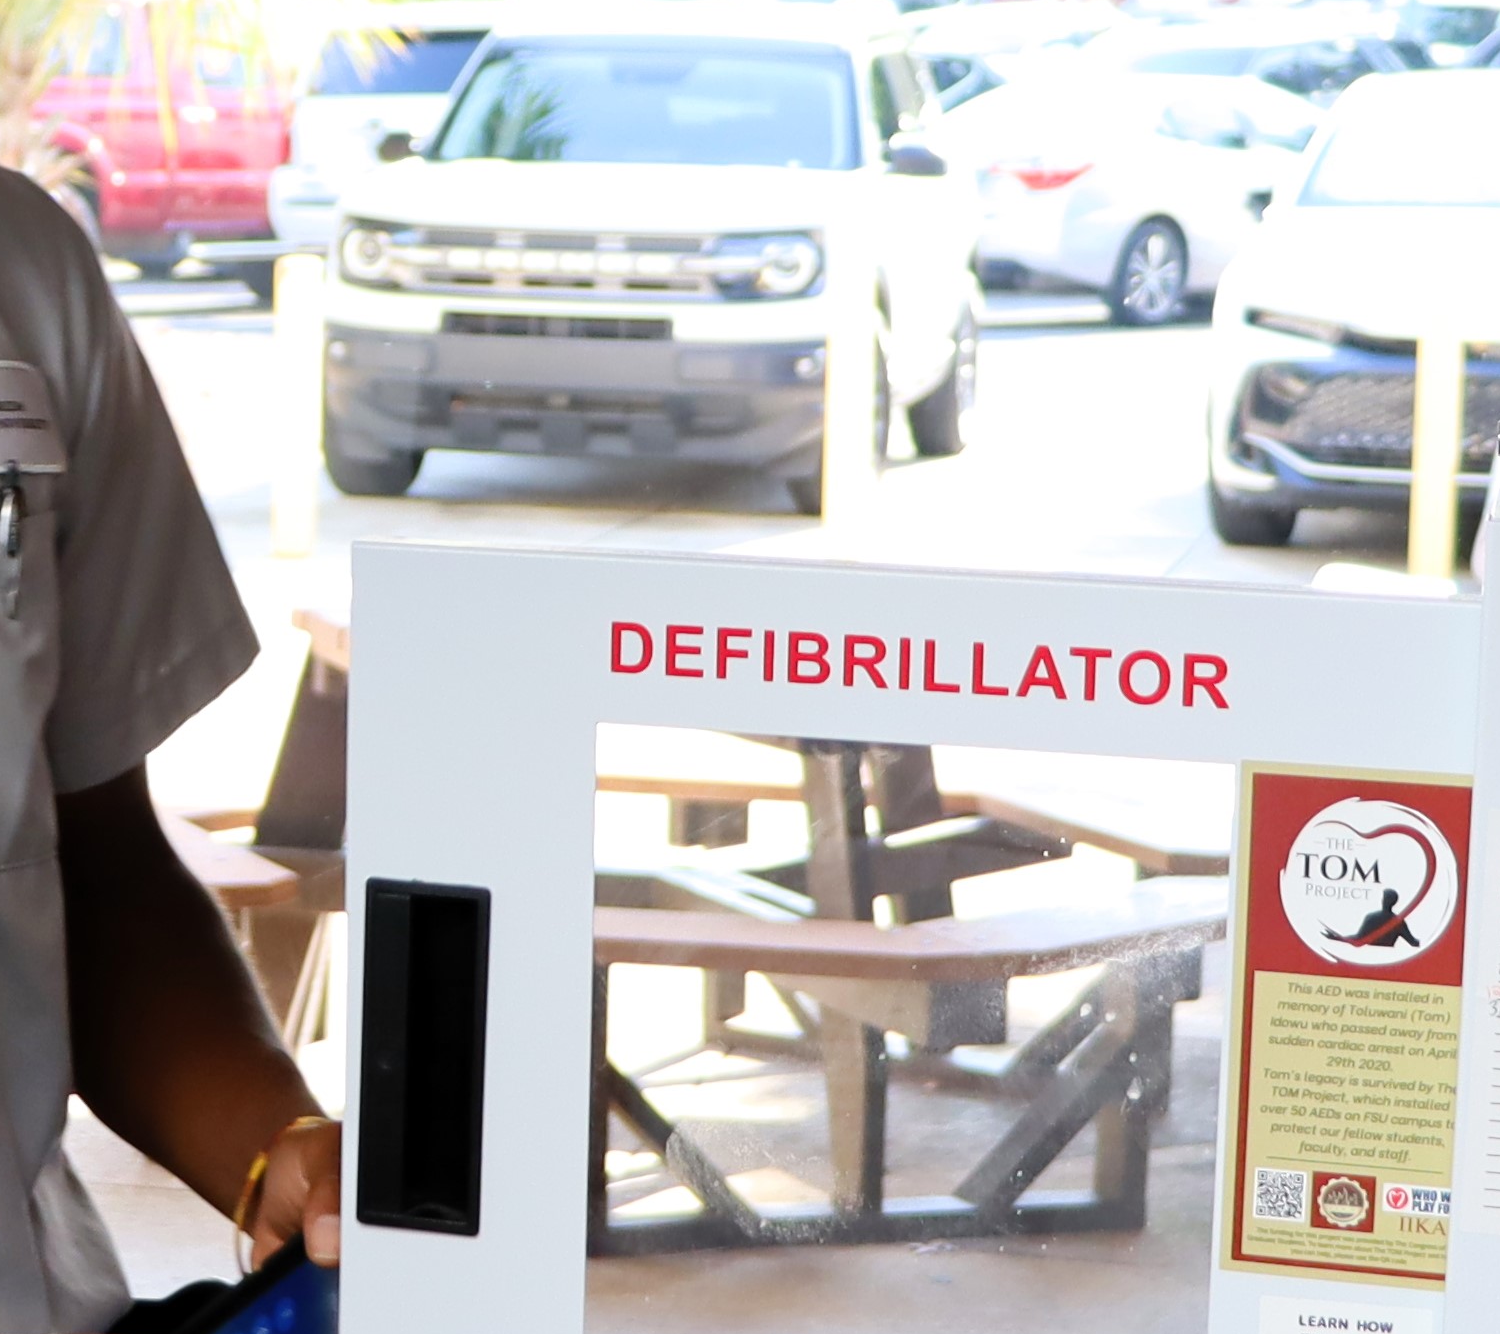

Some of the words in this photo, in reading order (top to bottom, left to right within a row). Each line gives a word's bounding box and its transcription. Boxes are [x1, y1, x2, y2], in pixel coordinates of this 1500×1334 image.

[610, 621, 1231, 709] DEFIBRILLATOR
[1325, 837, 1353, 850] THE
[1296, 853, 1381, 884] TOM
[1305, 884, 1371, 900] PROJECT
[1288, 983, 1313, 994] This
[1315, 985, 1342, 997] AED
[1345, 989, 1370, 999] was
[1374, 987, 1429, 1004] installed
[1432, 993, 1444, 1004] in
[1278, 1001, 1330, 1015] memory
[1333, 1005, 1346, 1017] of
[1349, 1005, 1407, 1018] Toluwani
[1411, 1010, 1450, 1023] (Tom)
[1312, 1020, 1338, 1032] who
[1341, 1023, 1386, 1036] passed
[1389, 1029, 1423, 1040] away
[1424, 1029, 1457, 1042] from
[1268, 1034, 1314, 1047] sudden
[1317, 1038, 1365, 1051] cardiac
[1368, 1044, 1405, 1055] arrest
[1408, 1048, 1424, 1057] on
[1427, 1048, 1457, 1060] April
[1326, 1056, 1355, 1068] 29th
[1358, 1059, 1393, 1071] 2020.
[1263, 1068, 1300, 1081] Tom's
[1304, 1070, 1345, 1087] legacy
[1349, 1075, 1359, 1086] is
[1362, 1078, 1416, 1091] survived
[1418, 1079, 1434, 1094] by
[1272, 1086, 1299, 1098] TOM
[1302, 1089, 1349, 1104] Project,
[1353, 1092, 1391, 1106] which
[1394, 1096, 1449, 1111] installed
[1260, 1105, 1287, 1115] over
[1291, 1105, 1307, 1116] 50
[1309, 1109, 1342, 1119] AEDs
[1344, 1112, 1360, 1120] on
[1364, 1111, 1389, 1123] FSU
[1391, 1117, 1443, 1130] campus
[1270, 1122, 1317, 1134] protect
[1320, 1127, 1341, 1136] our
[1343, 1127, 1383, 1141] fellow
[1386, 1132, 1445, 1147] students,
[1299, 1141, 1347, 1156] faculty,
[1351, 1147, 1375, 1158] and
[1379, 1149, 1411, 1163] staff.
[1441, 1191, 1450, 1202] W
[1438, 1203, 1450, 1214] FO
[1298, 1315, 1348, 1330] LEARN
[1357, 1319, 1394, 1334] HOW
